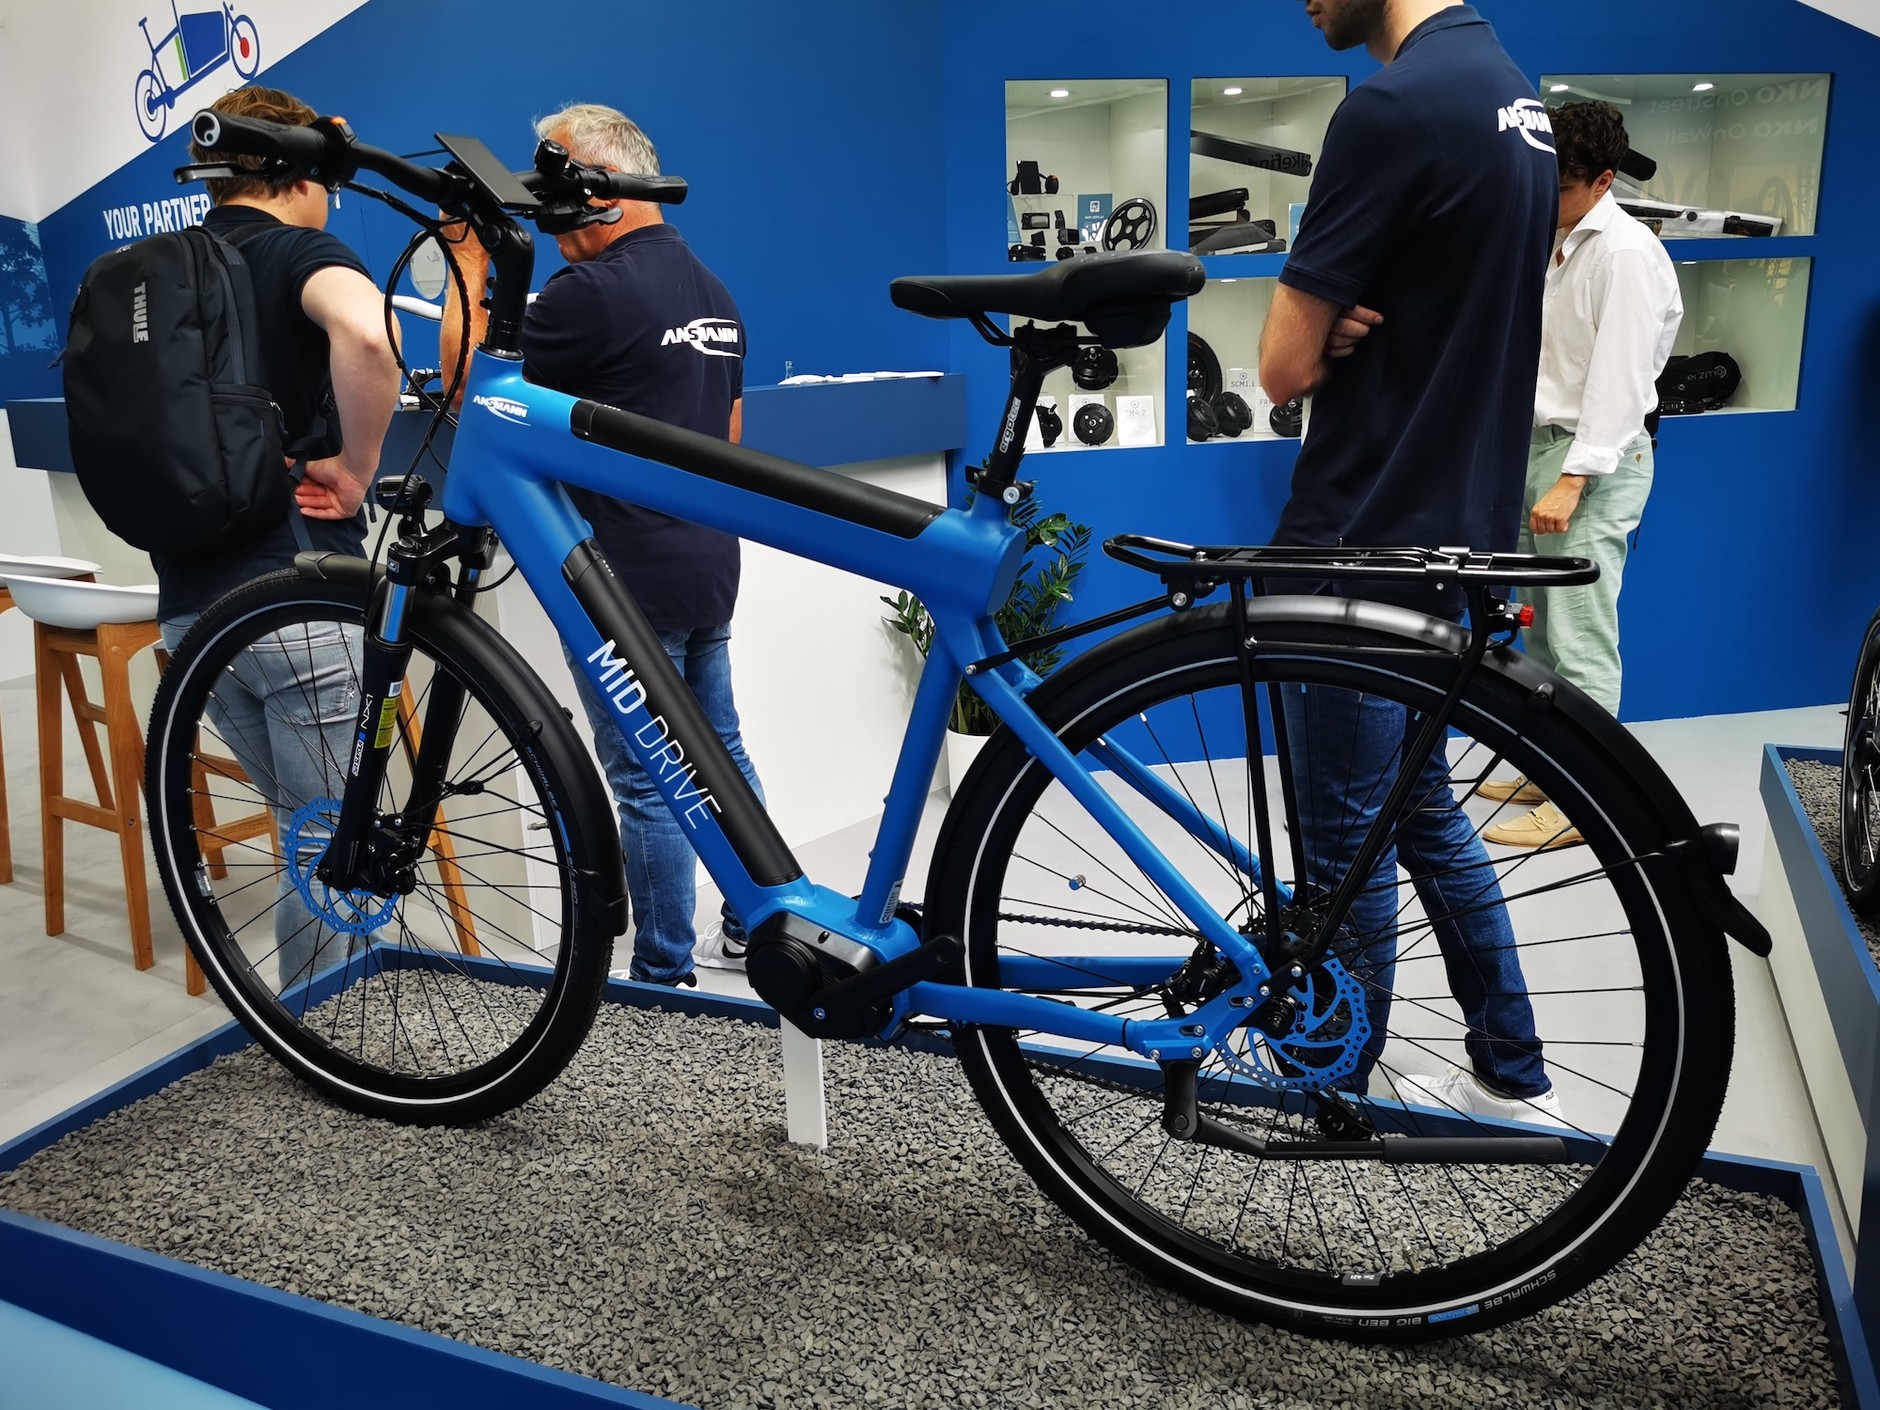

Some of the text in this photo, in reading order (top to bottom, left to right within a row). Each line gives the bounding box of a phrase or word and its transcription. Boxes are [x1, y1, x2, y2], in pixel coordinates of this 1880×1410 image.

[103, 204, 143, 241] YOUR
[133, 281, 149, 344] THULE
[660, 323, 739, 348] ANSMANN
[472, 394, 529, 419] ANSMANN
[999, 396, 1021, 453] ergotec
[586, 638, 723, 830] MID DRIVE
[1484, 1268, 1557, 1311] SCHWALBE
[1396, 1316, 1422, 1327] BIG
